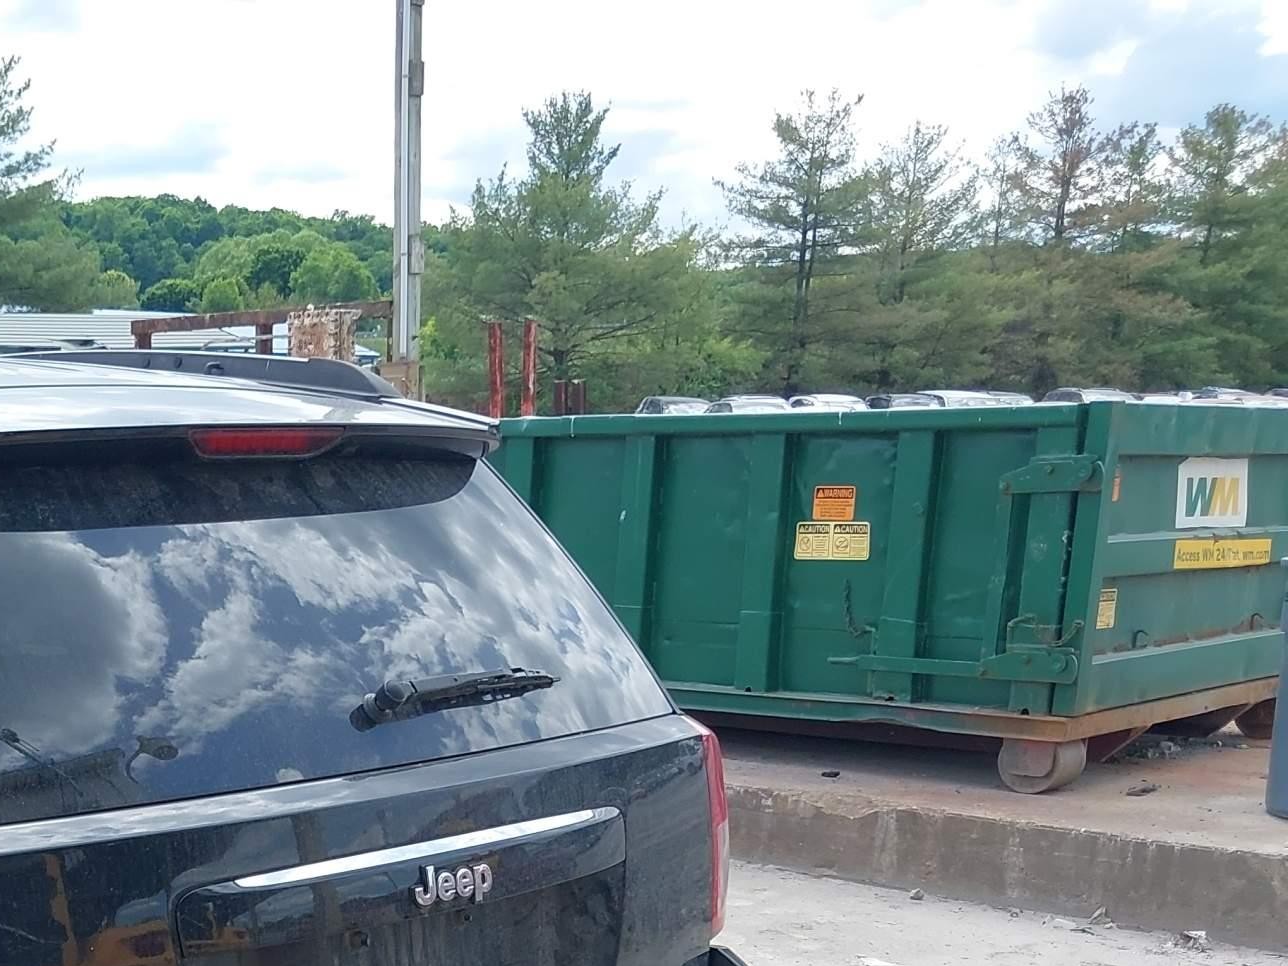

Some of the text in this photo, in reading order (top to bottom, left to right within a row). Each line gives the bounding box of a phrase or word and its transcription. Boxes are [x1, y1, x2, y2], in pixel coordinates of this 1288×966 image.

[824, 489, 853, 498] WARNING
[1185, 477, 1240, 517] WM
[805, 525, 830, 533] CAUTION
[840, 525, 868, 533] CAUTION
[1177, 548, 1200, 562] Access
[415, 864, 492, 905] Jeep
